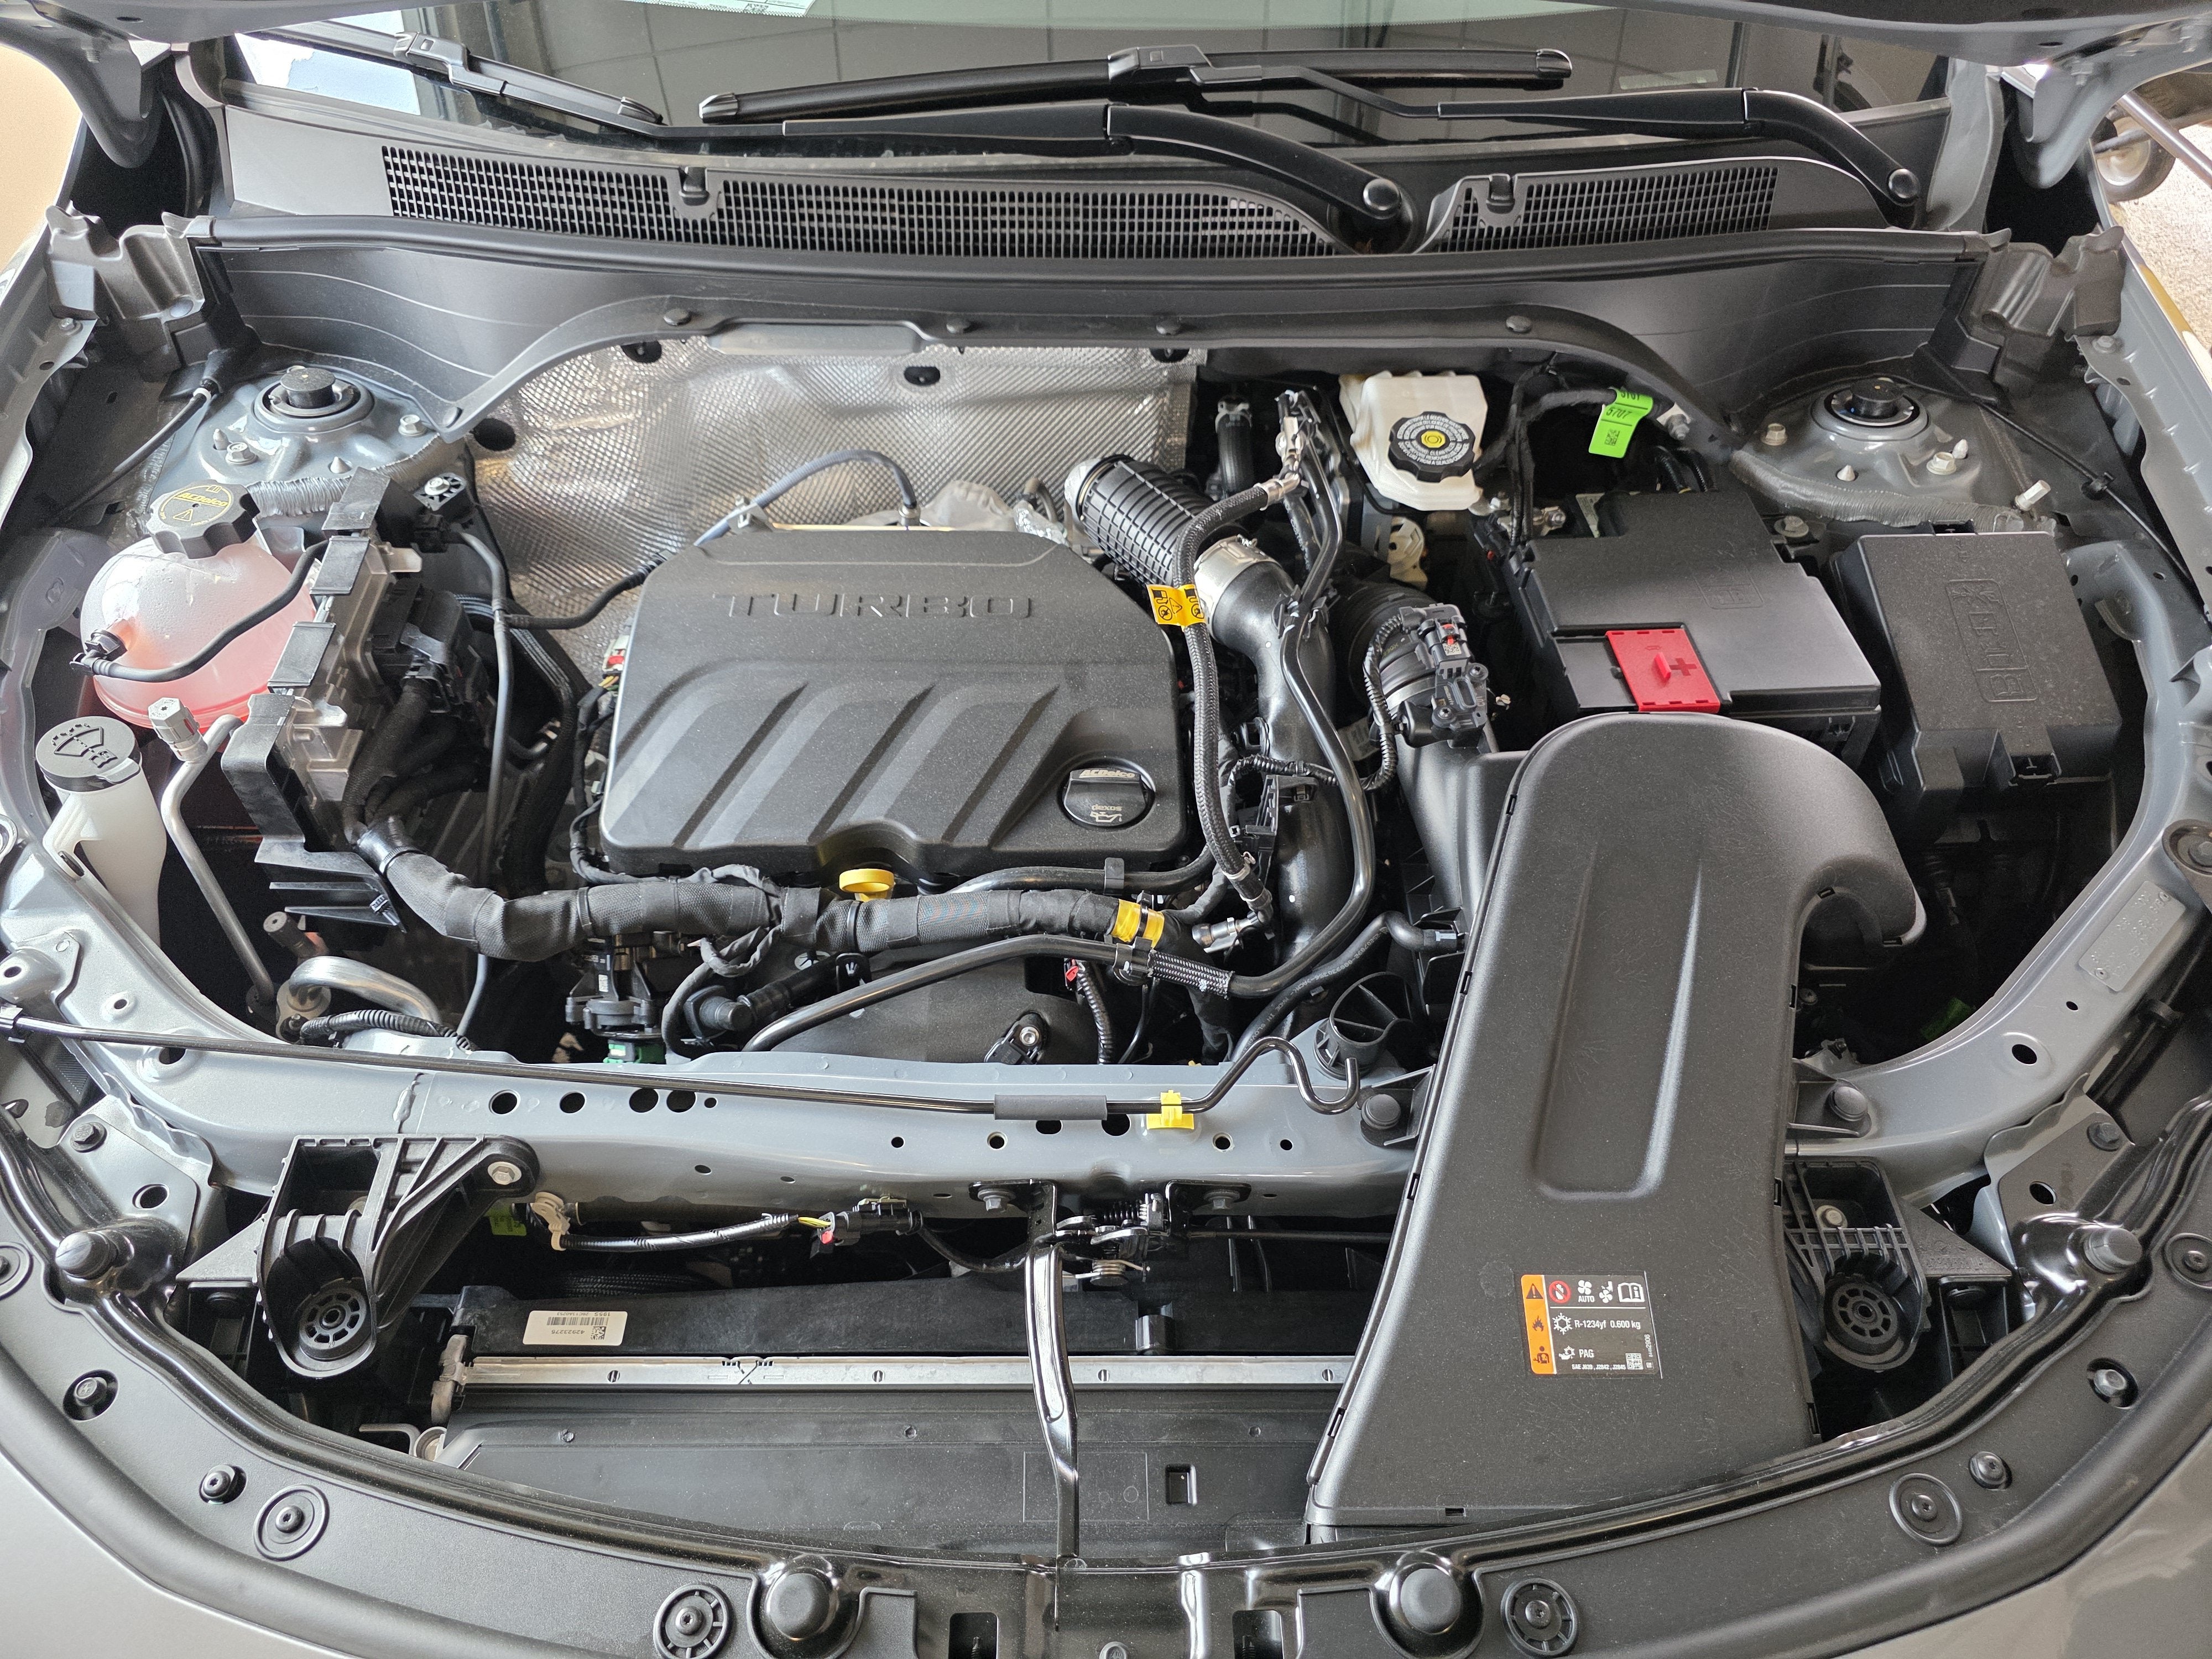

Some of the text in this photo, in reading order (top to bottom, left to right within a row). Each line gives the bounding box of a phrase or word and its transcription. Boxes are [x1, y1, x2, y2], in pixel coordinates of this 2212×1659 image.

[1606, 407, 1632, 419] 5707
[178, 493, 229, 507] ACDelco
[712, 592, 1034, 619] TURBO
[1080, 769, 1135, 778] ACDelco
[1574, 1320, 1641, 1330] R-1234yf 0.600 kg
[1578, 1349, 1594, 1358] PAG
